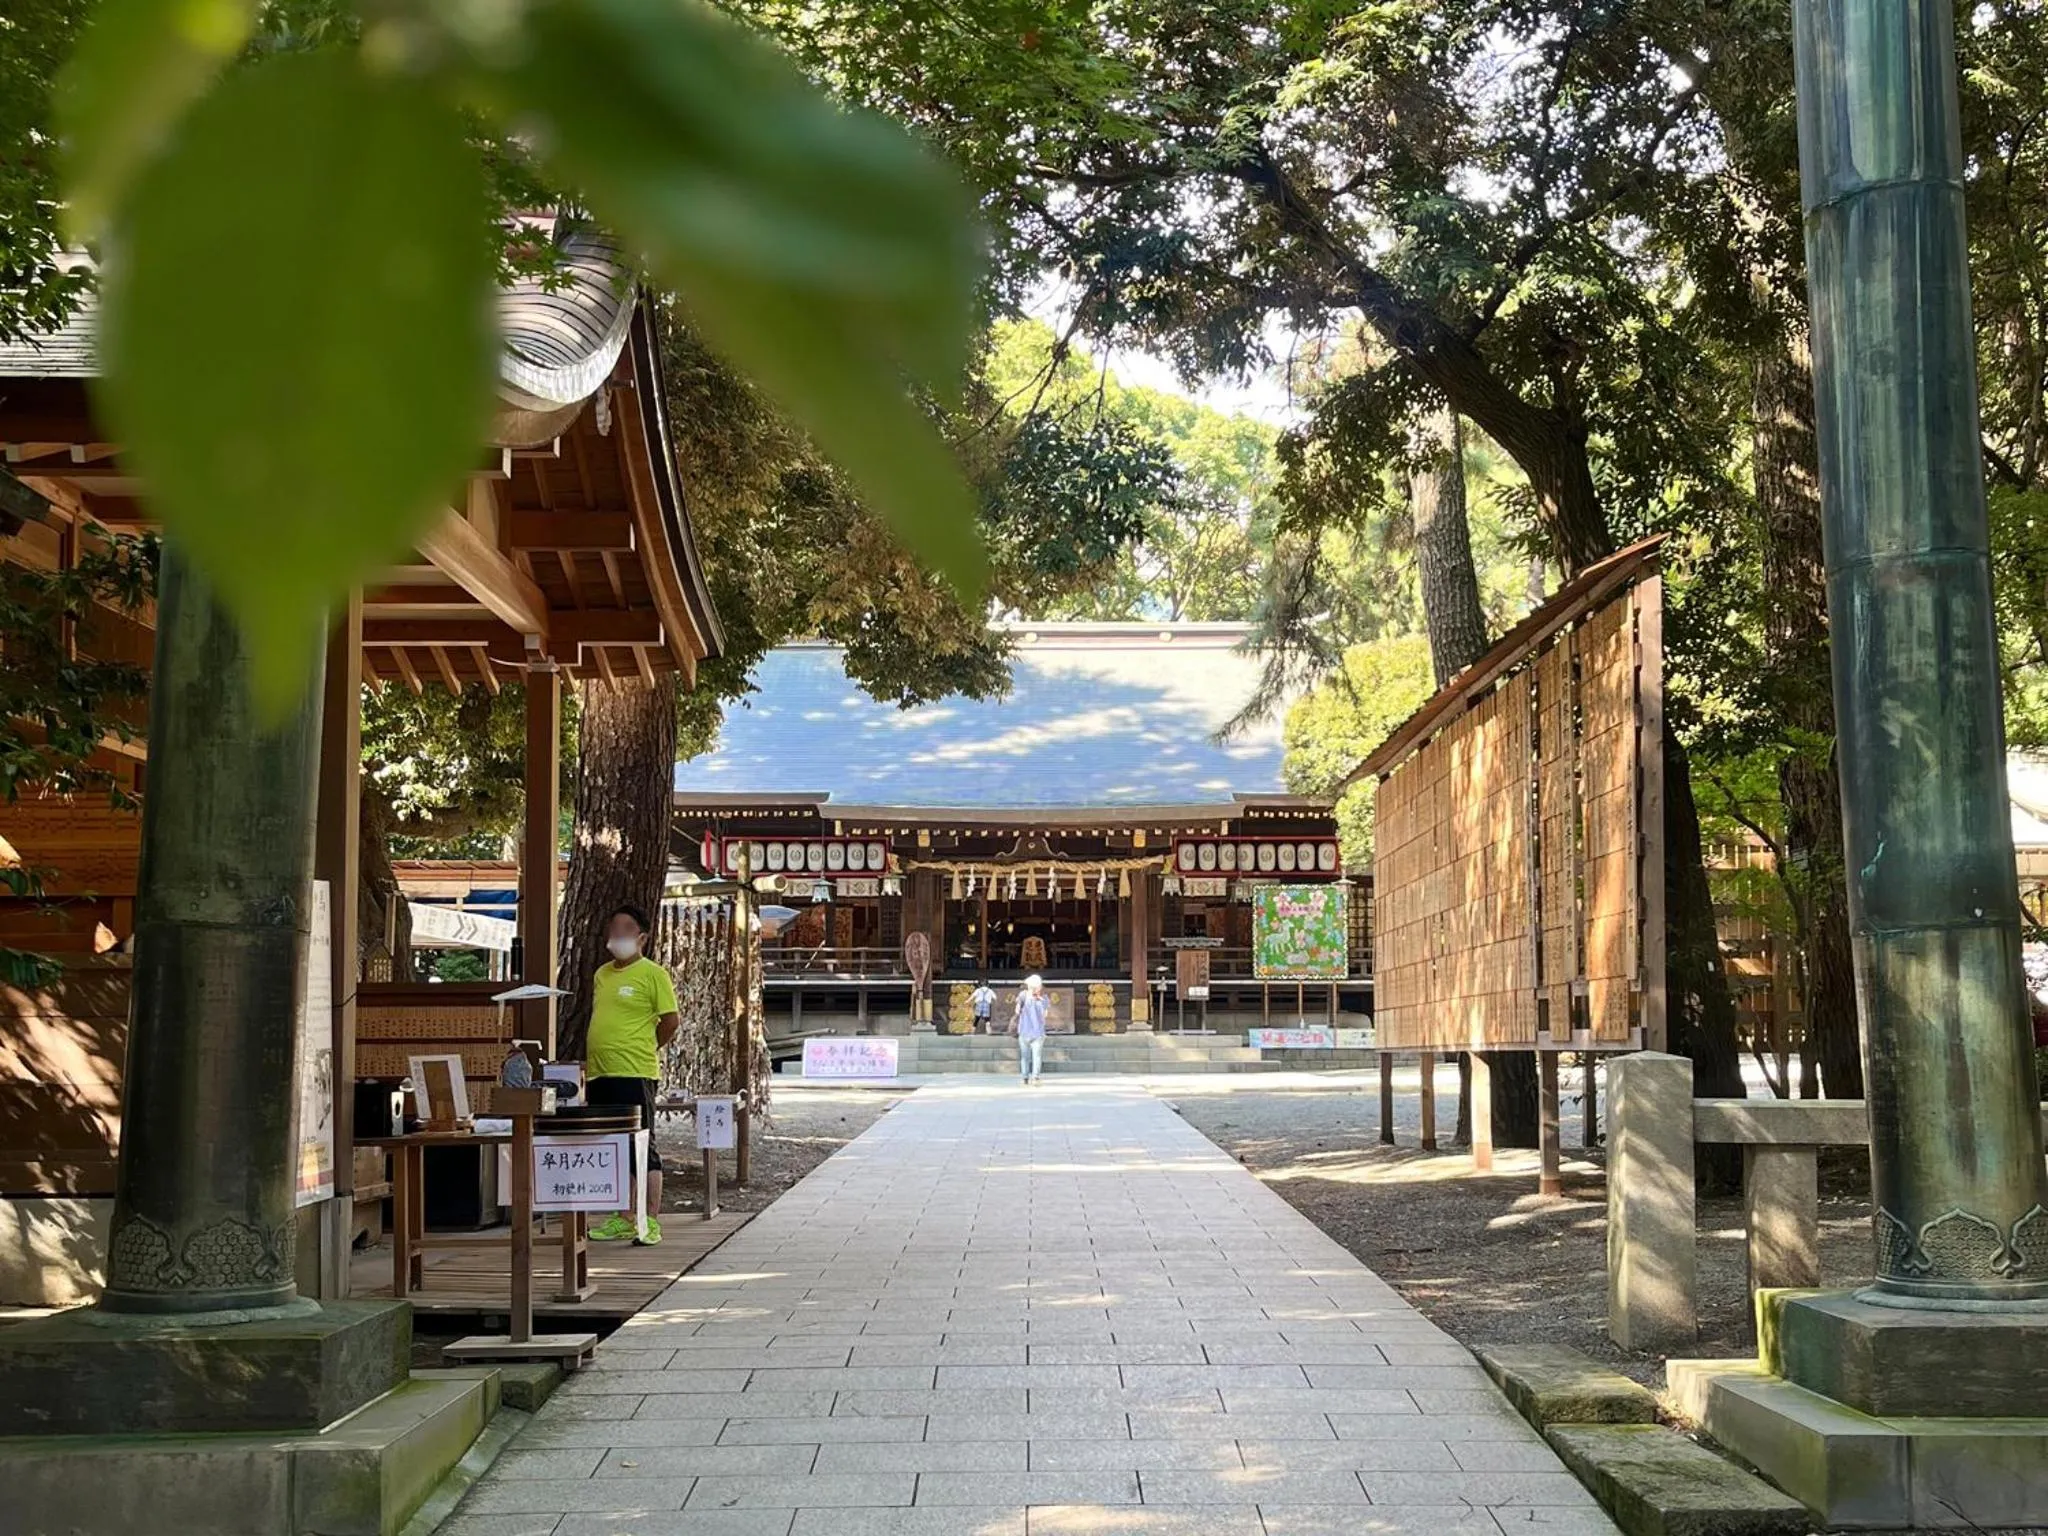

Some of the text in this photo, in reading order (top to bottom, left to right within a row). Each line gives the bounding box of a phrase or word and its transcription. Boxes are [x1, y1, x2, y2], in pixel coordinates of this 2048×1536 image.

[541, 1151, 610, 1170] 皐月みくじ
